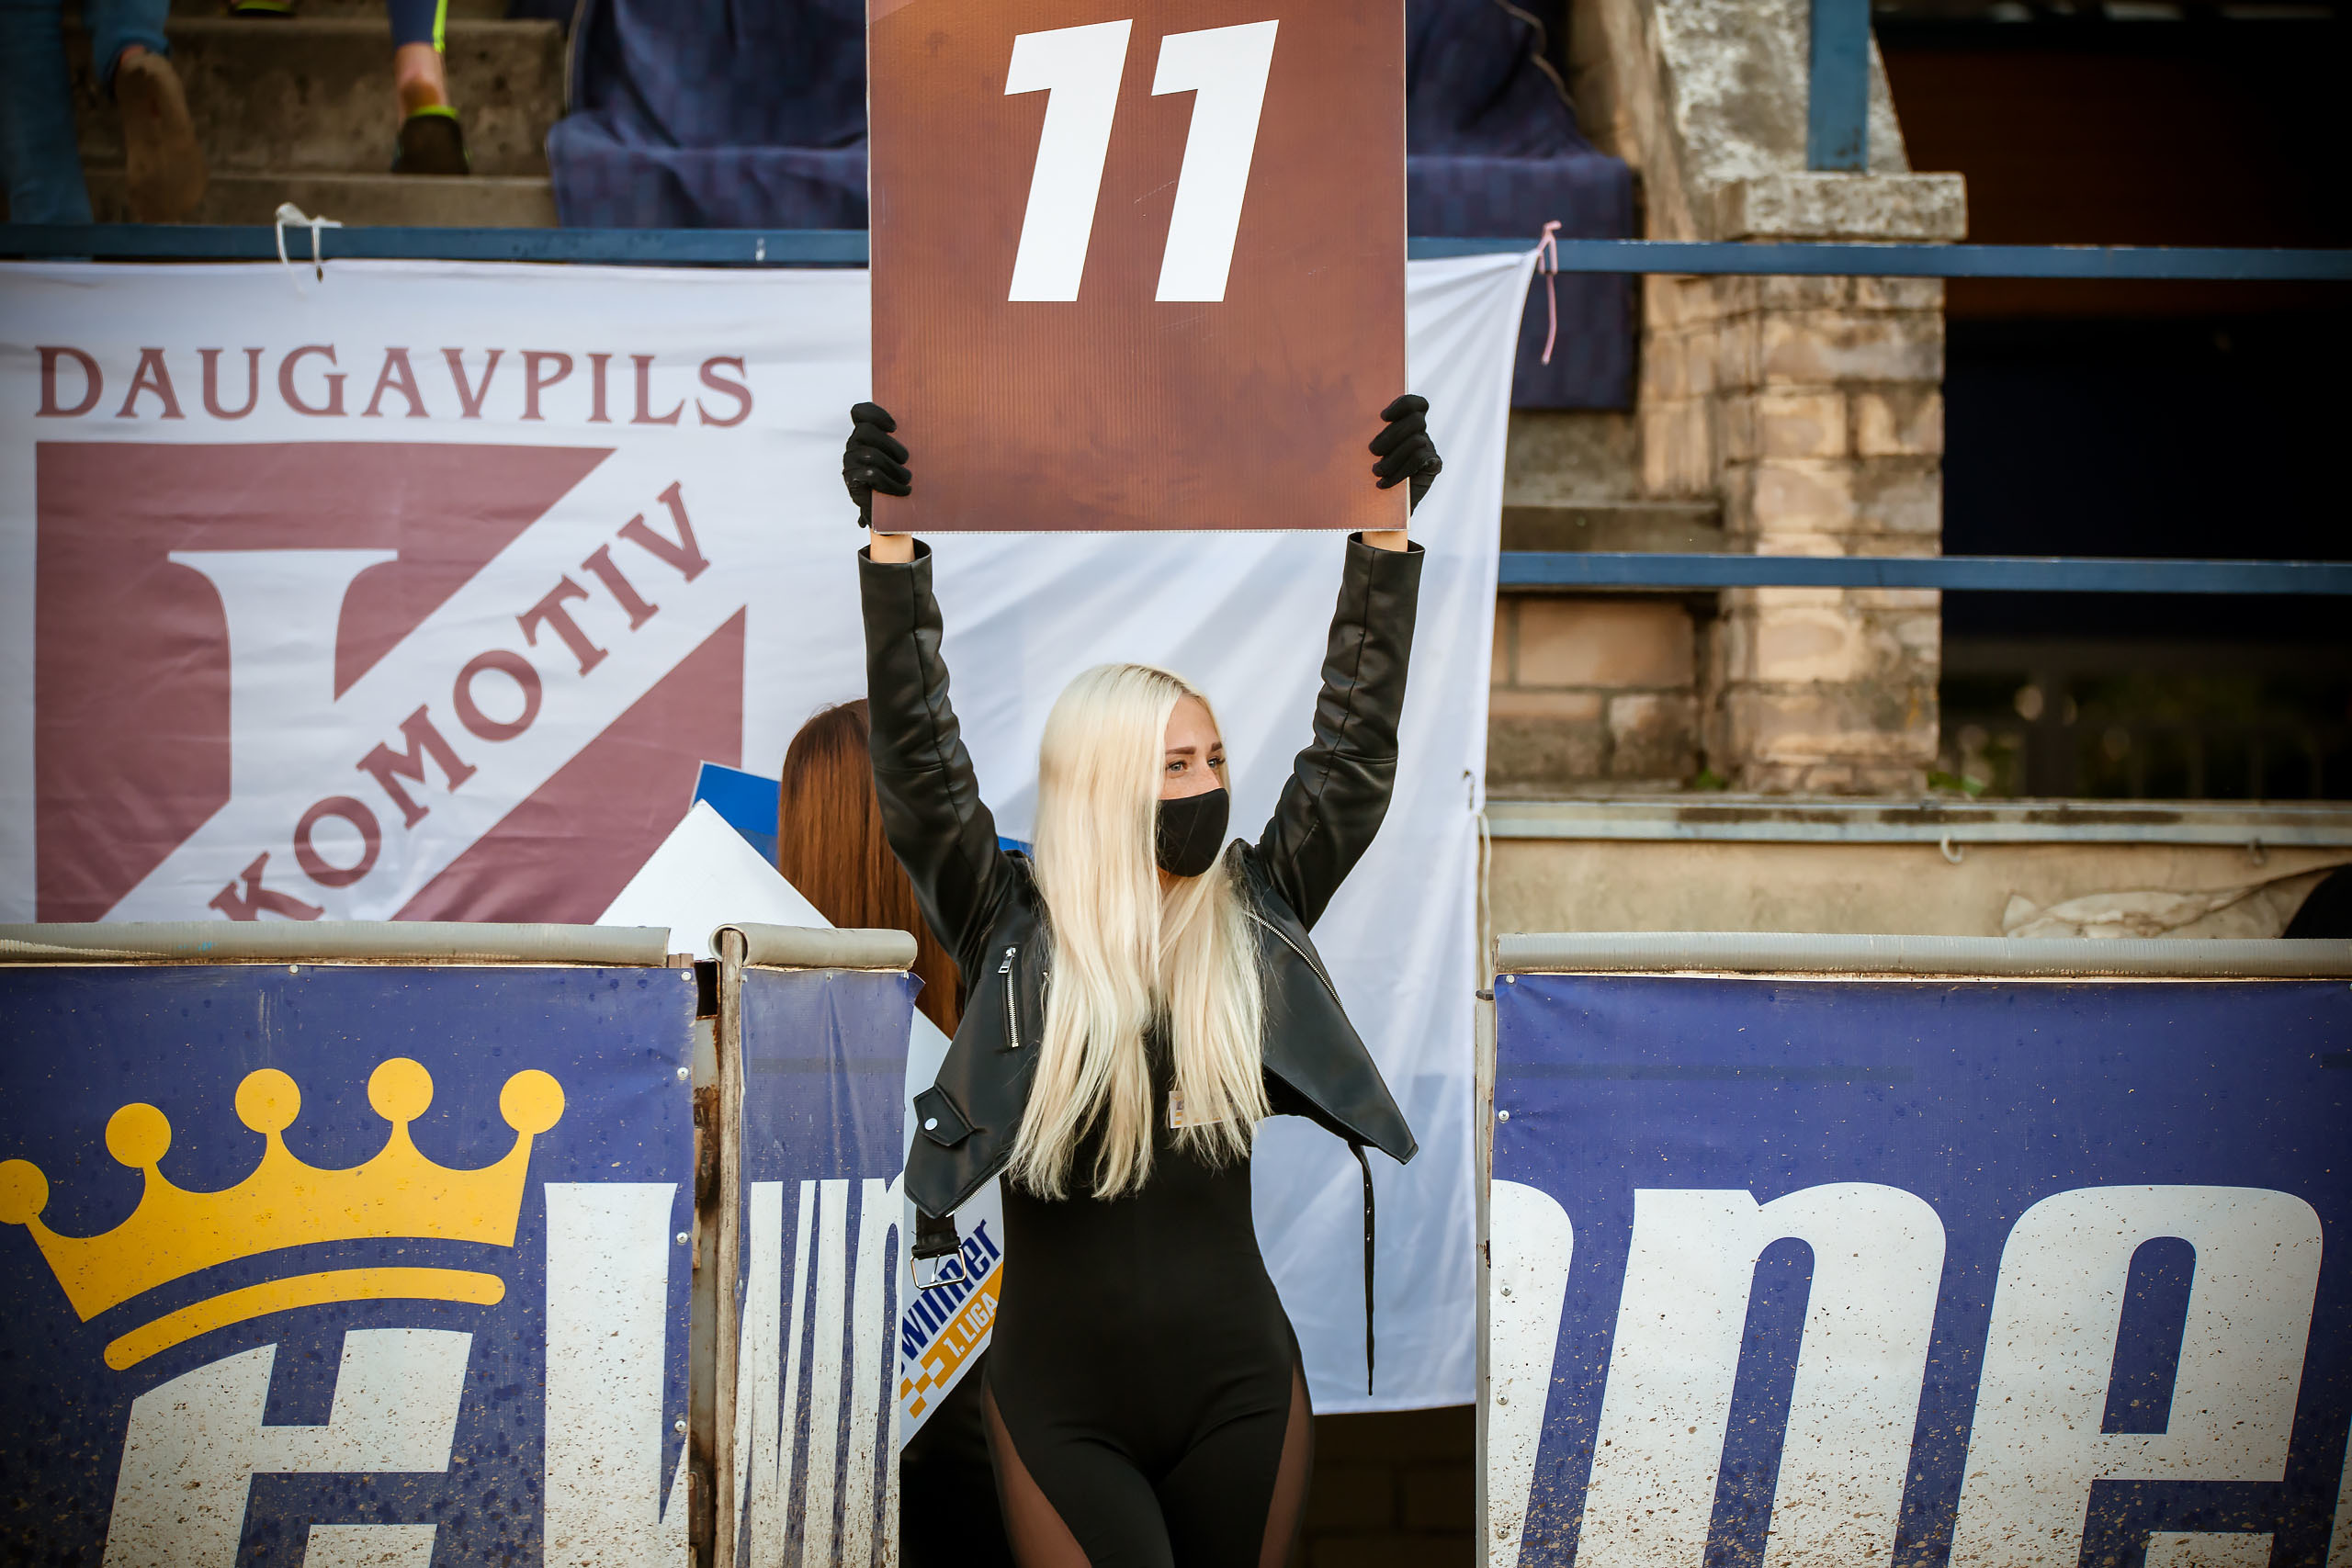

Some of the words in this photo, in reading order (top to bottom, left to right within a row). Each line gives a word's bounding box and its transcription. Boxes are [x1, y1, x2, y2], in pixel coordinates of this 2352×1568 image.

[1003, 18, 1280, 302] 11
[33, 343, 754, 428] DAUGAVPILS
[901, 1219, 1001, 1375] winner
[943, 1338, 966, 1359] 1.
[957, 1292, 999, 1341] LIGA
